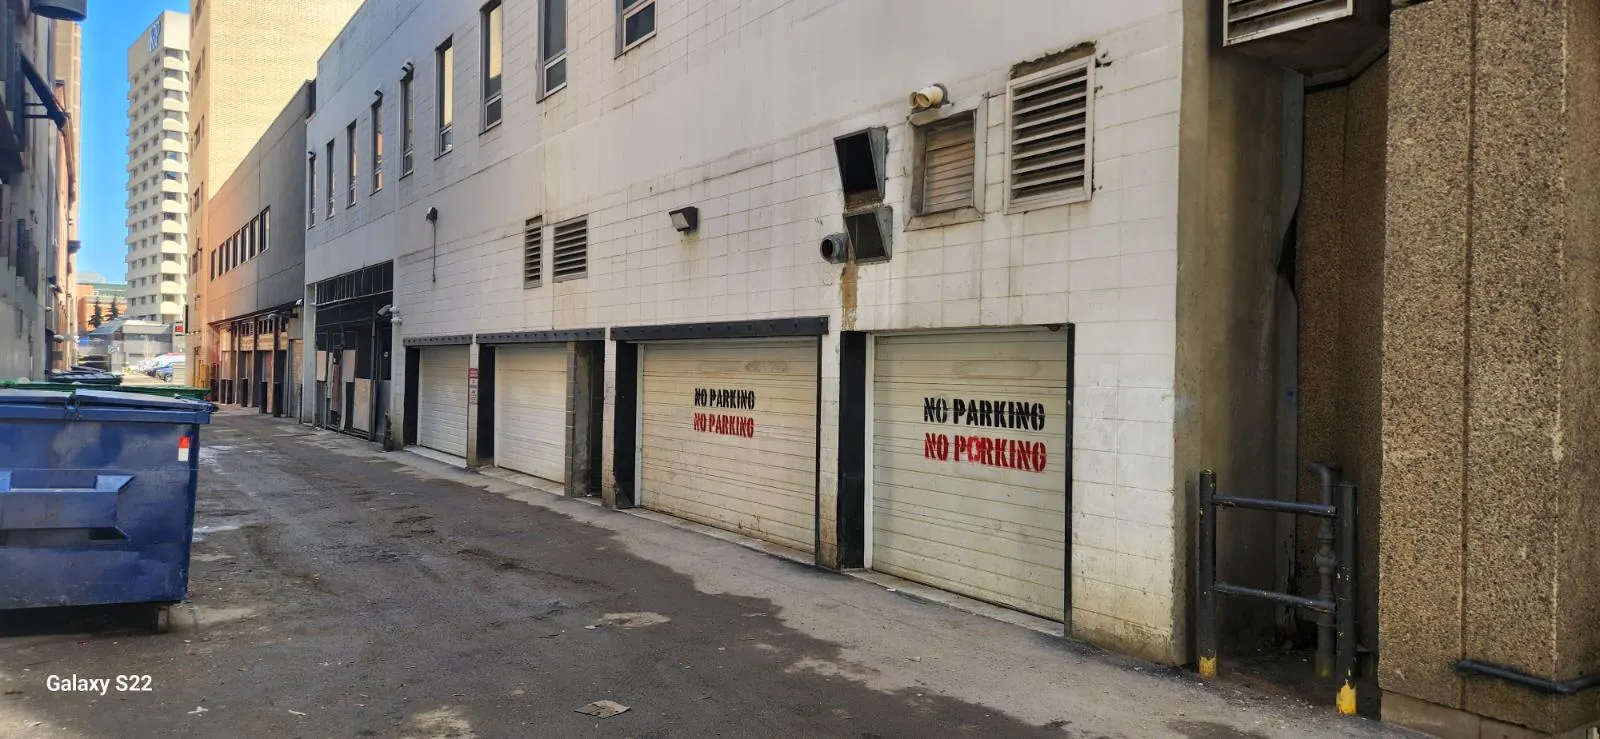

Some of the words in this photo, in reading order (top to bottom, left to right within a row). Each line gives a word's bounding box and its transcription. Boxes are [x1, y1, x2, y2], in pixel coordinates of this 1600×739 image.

[694, 388, 707, 407] NO
[709, 389, 755, 410] PARKING
[694, 412, 707, 432] NO
[709, 413, 754, 438] PARKING
[924, 397, 948, 423] NO
[953, 398, 1045, 431] PARKING
[924, 432, 949, 461] NO
